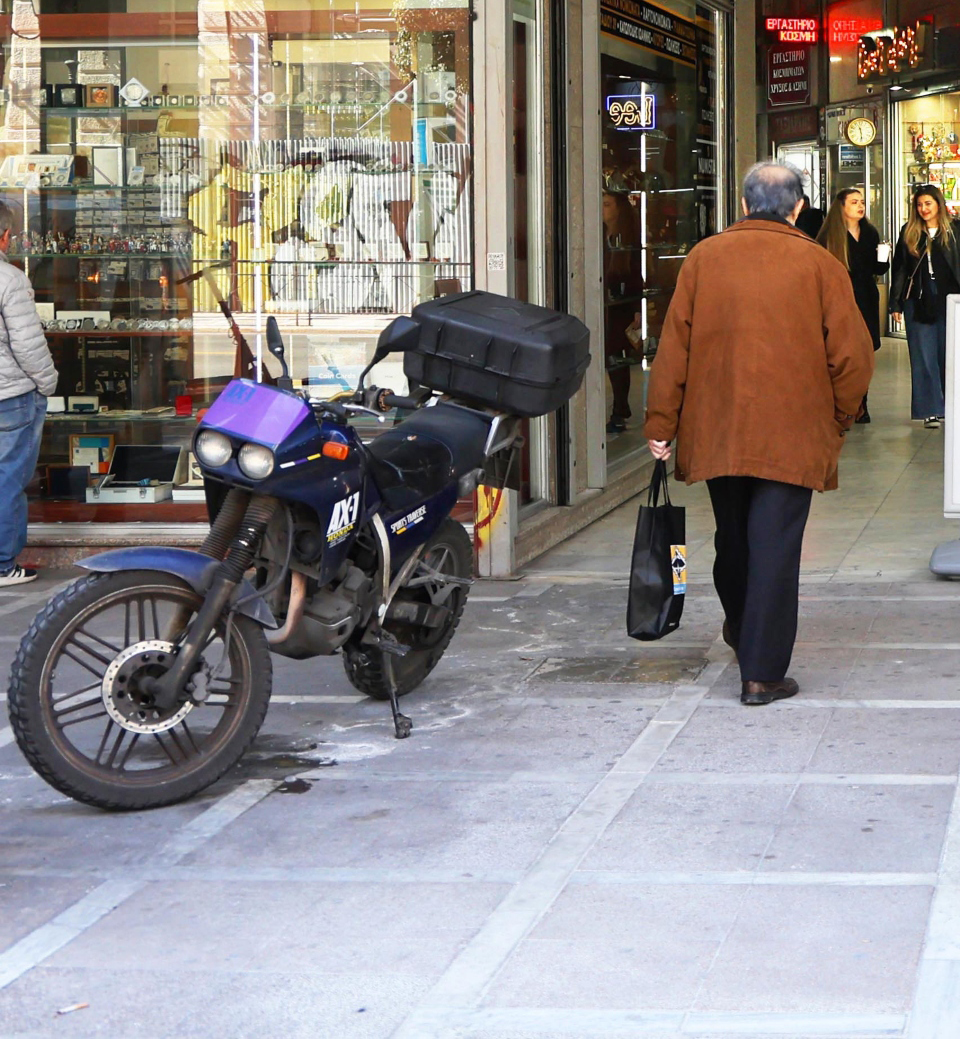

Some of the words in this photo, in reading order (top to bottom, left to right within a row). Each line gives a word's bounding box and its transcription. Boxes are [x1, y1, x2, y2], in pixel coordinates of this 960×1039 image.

[766, 18, 816, 30] ΕΡΓΑΣΤΗΡΙΟ
[780, 30, 816, 42] ΚΟΣΜΗ
[772, 50, 805, 64] ΕΡΓΑΣΤΗΡΙΟ
[326, 523, 355, 543] HONDA
